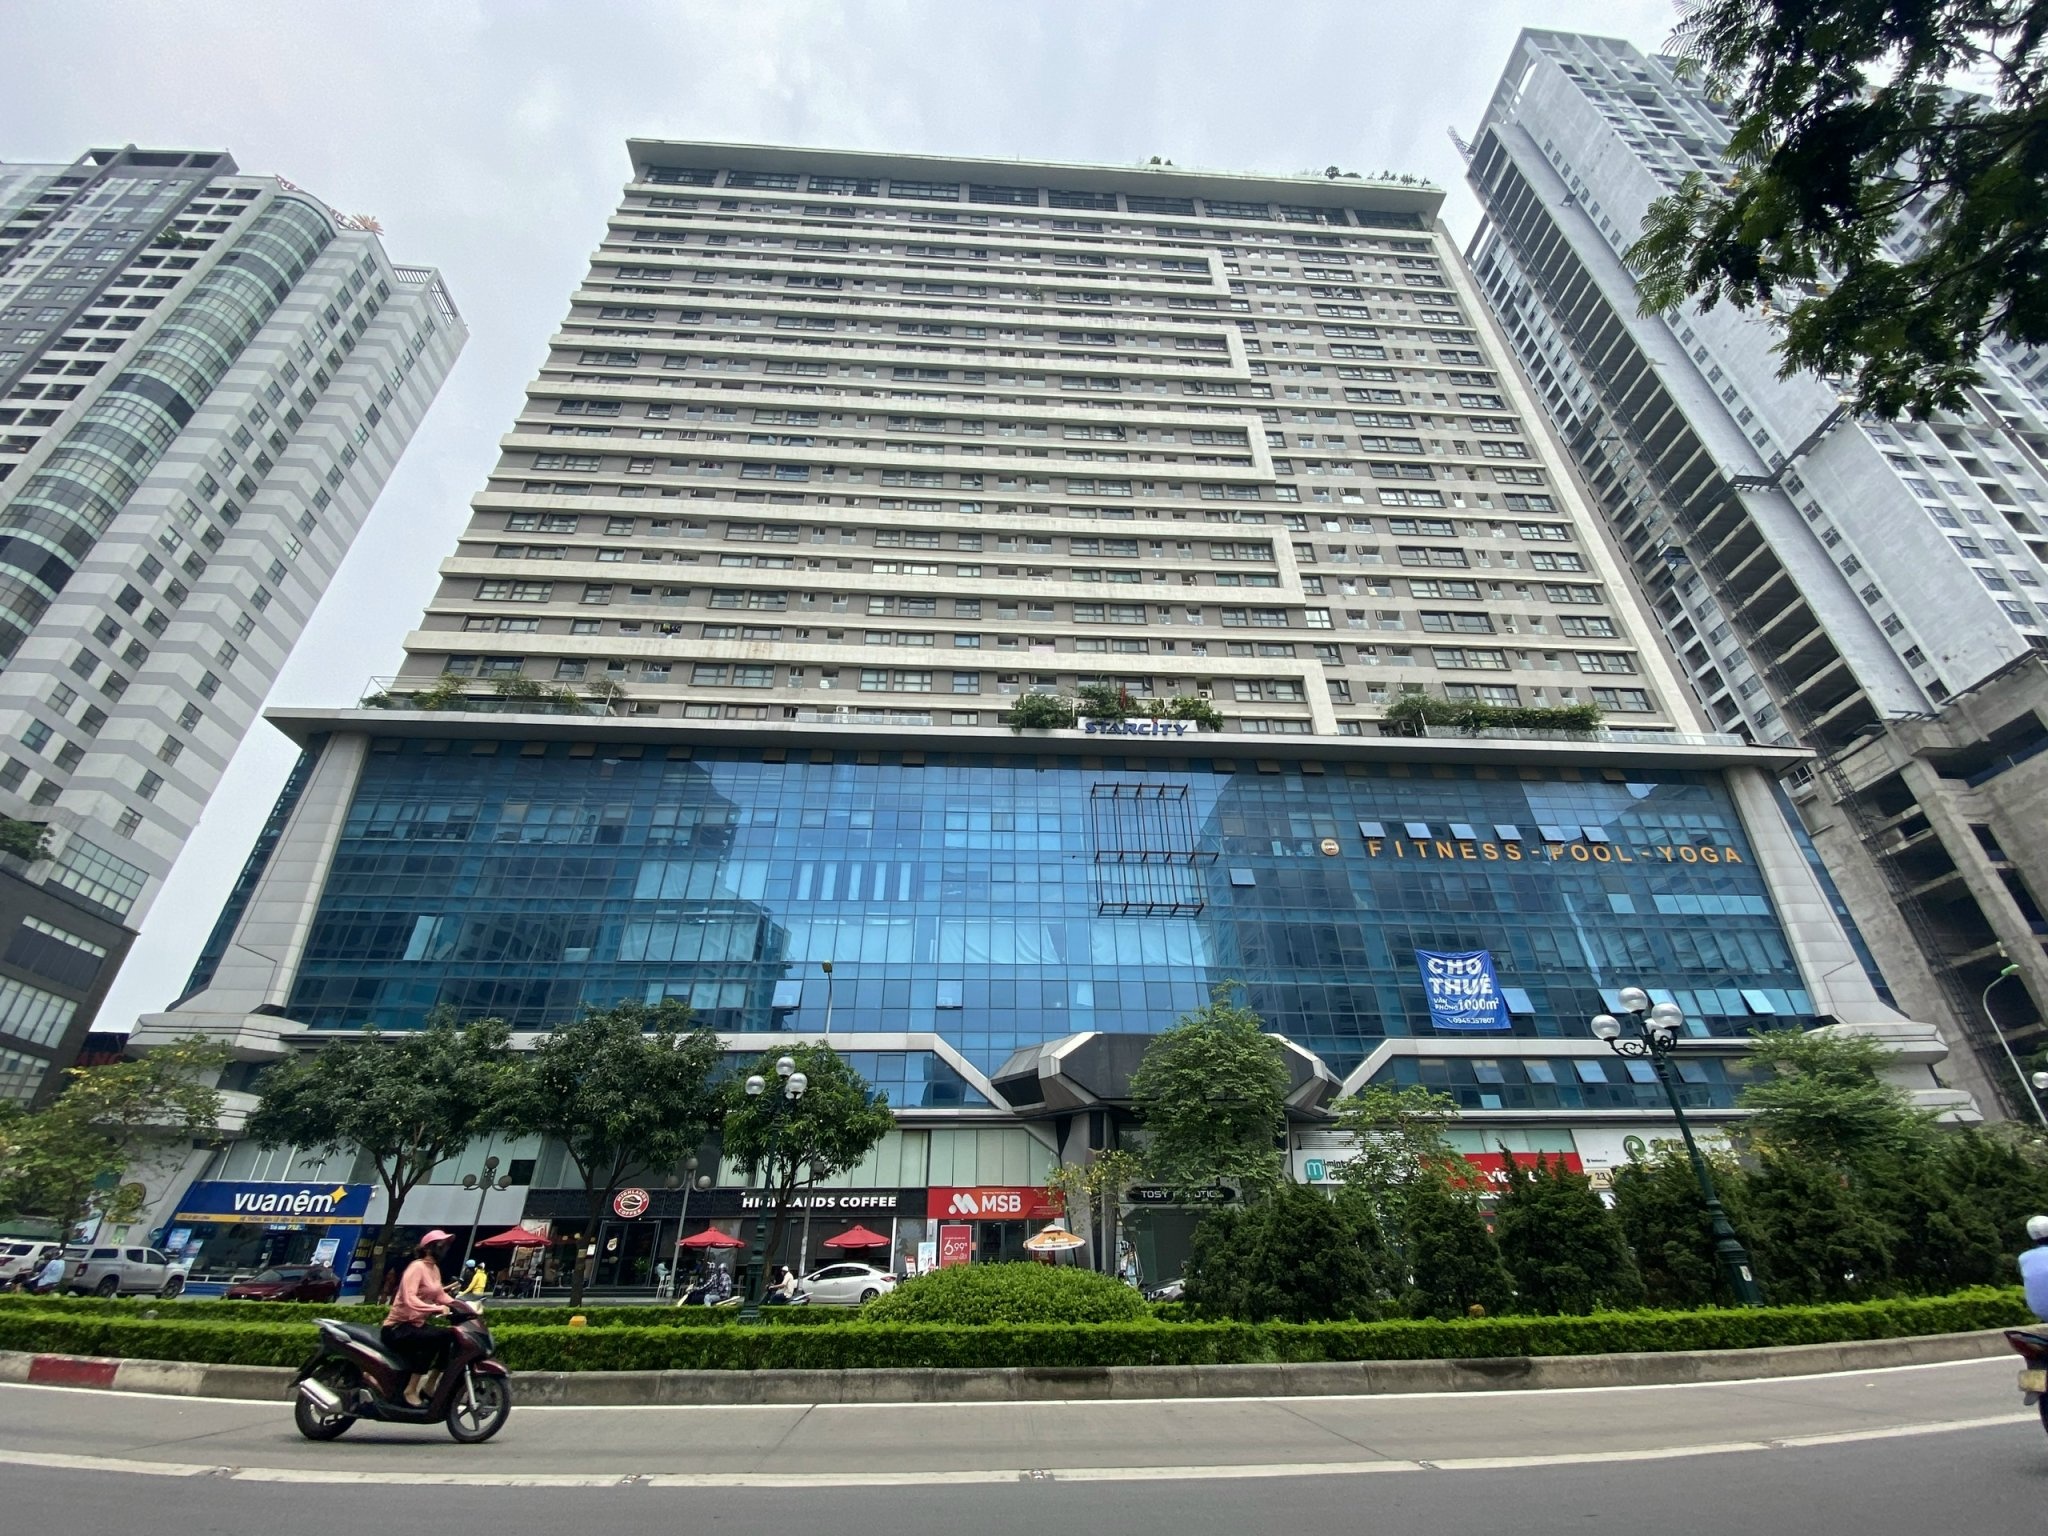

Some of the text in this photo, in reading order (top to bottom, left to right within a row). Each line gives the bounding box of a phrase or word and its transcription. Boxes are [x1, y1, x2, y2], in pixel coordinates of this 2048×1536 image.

[1085, 721, 1188, 736] STARCITY
[1367, 839, 1522, 861] FITNESS
[1550, 843, 1633, 862] POOL
[1657, 845, 1743, 864] YOGA
[1427, 957, 1482, 975] CHO
[1428, 972, 1493, 995] THUÊ
[617, 1190, 648, 1202] HIGHLANDS
[839, 1196, 897, 1208] COFFEE
[1141, 1190, 1169, 1199] TOSY
[981, 1194, 1021, 1213] MSB
[618, 1208, 642, 1216] COFFEE
